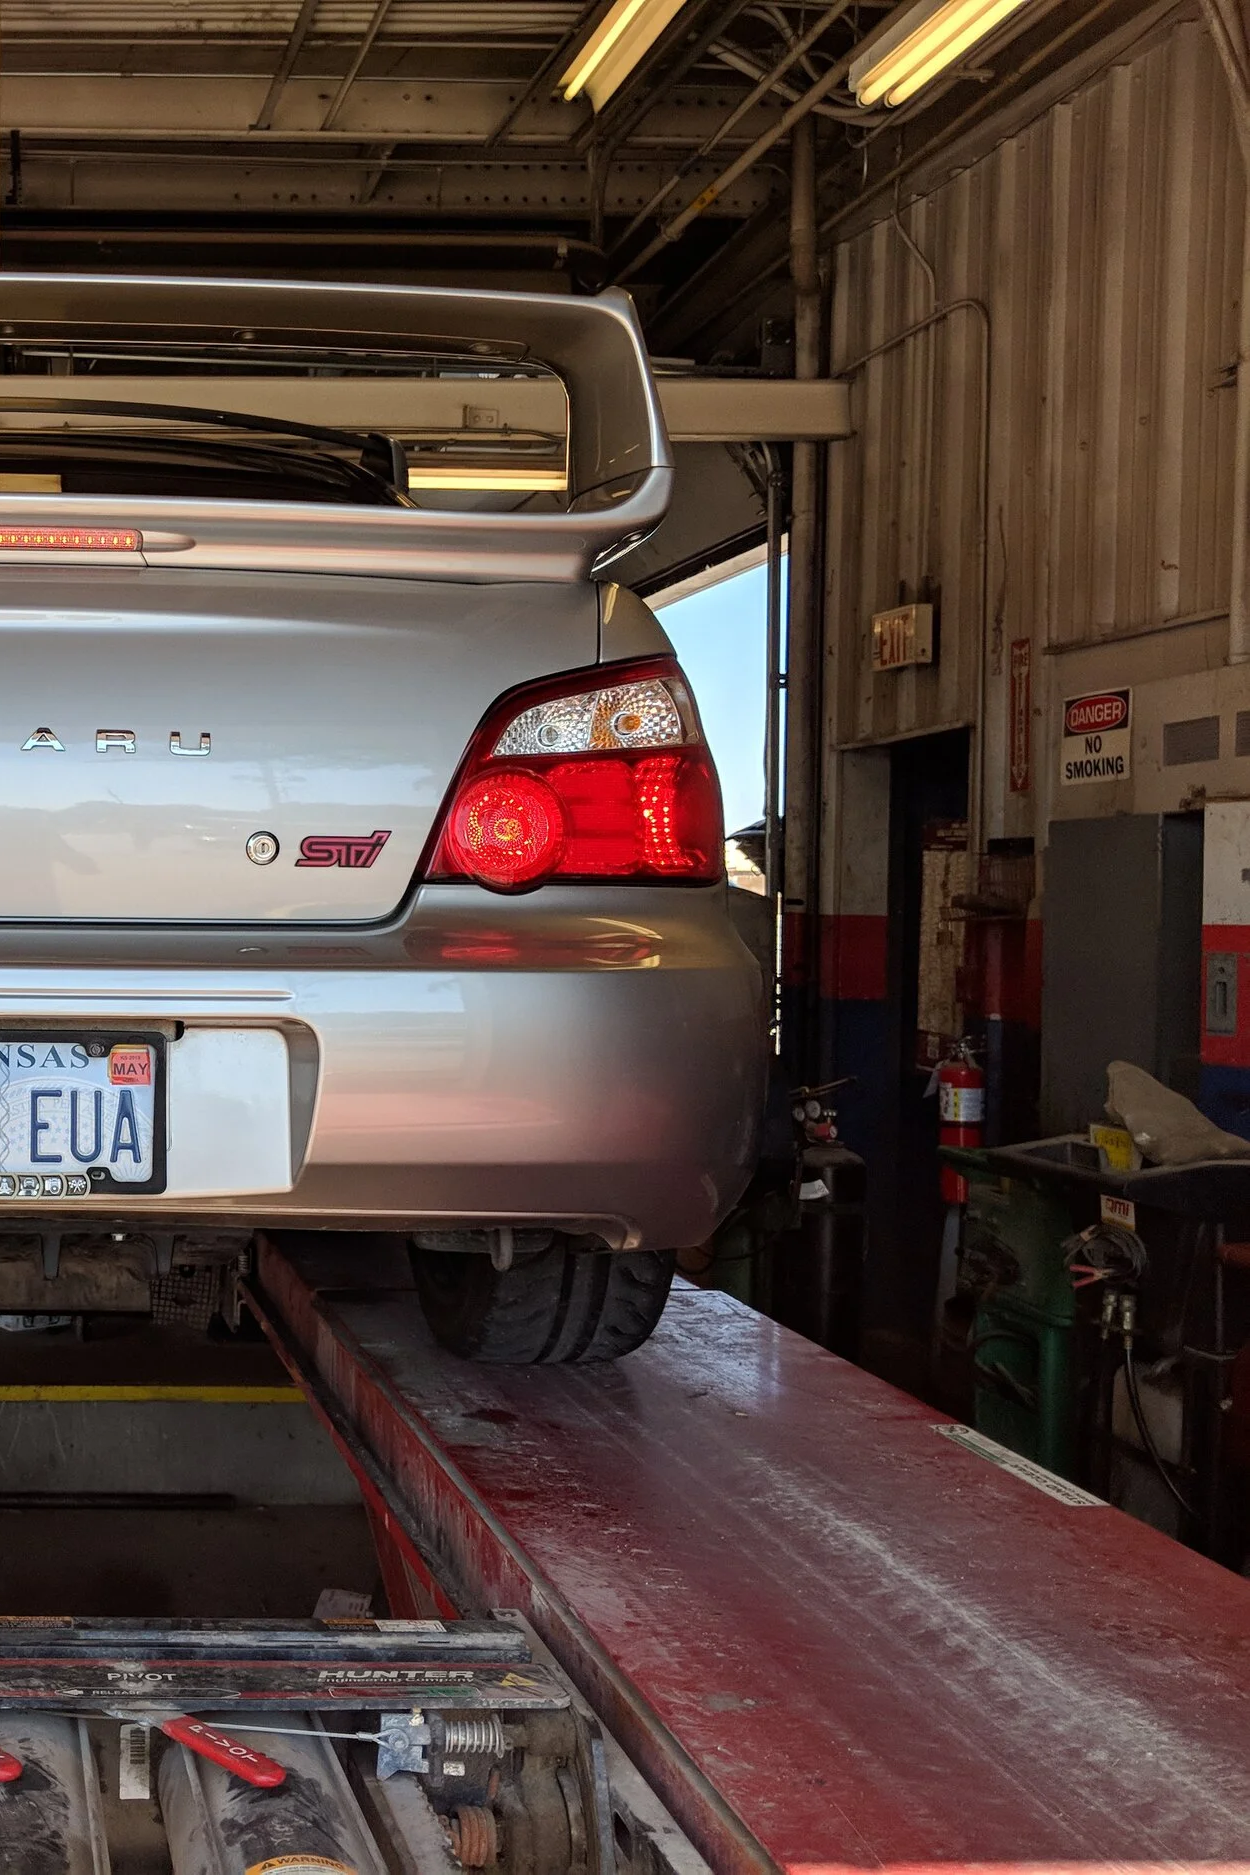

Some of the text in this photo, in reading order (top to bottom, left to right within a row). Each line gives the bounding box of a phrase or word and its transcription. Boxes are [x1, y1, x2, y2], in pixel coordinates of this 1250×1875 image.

[879, 613, 910, 666] EXIT
[1070, 701, 1122, 728] DANGER
[1084, 734, 1103, 755] NO
[1065, 755, 1125, 780] SMOKING
[113, 1062, 148, 1075] MAY
[30, 1088, 142, 1163] EUA
[107, 1672, 177, 1681] PIVOT
[318, 1670, 476, 1679] HUNTER
[187, 1724, 258, 1763] PIVOT
[276, 1855, 346, 1870] WARNING
